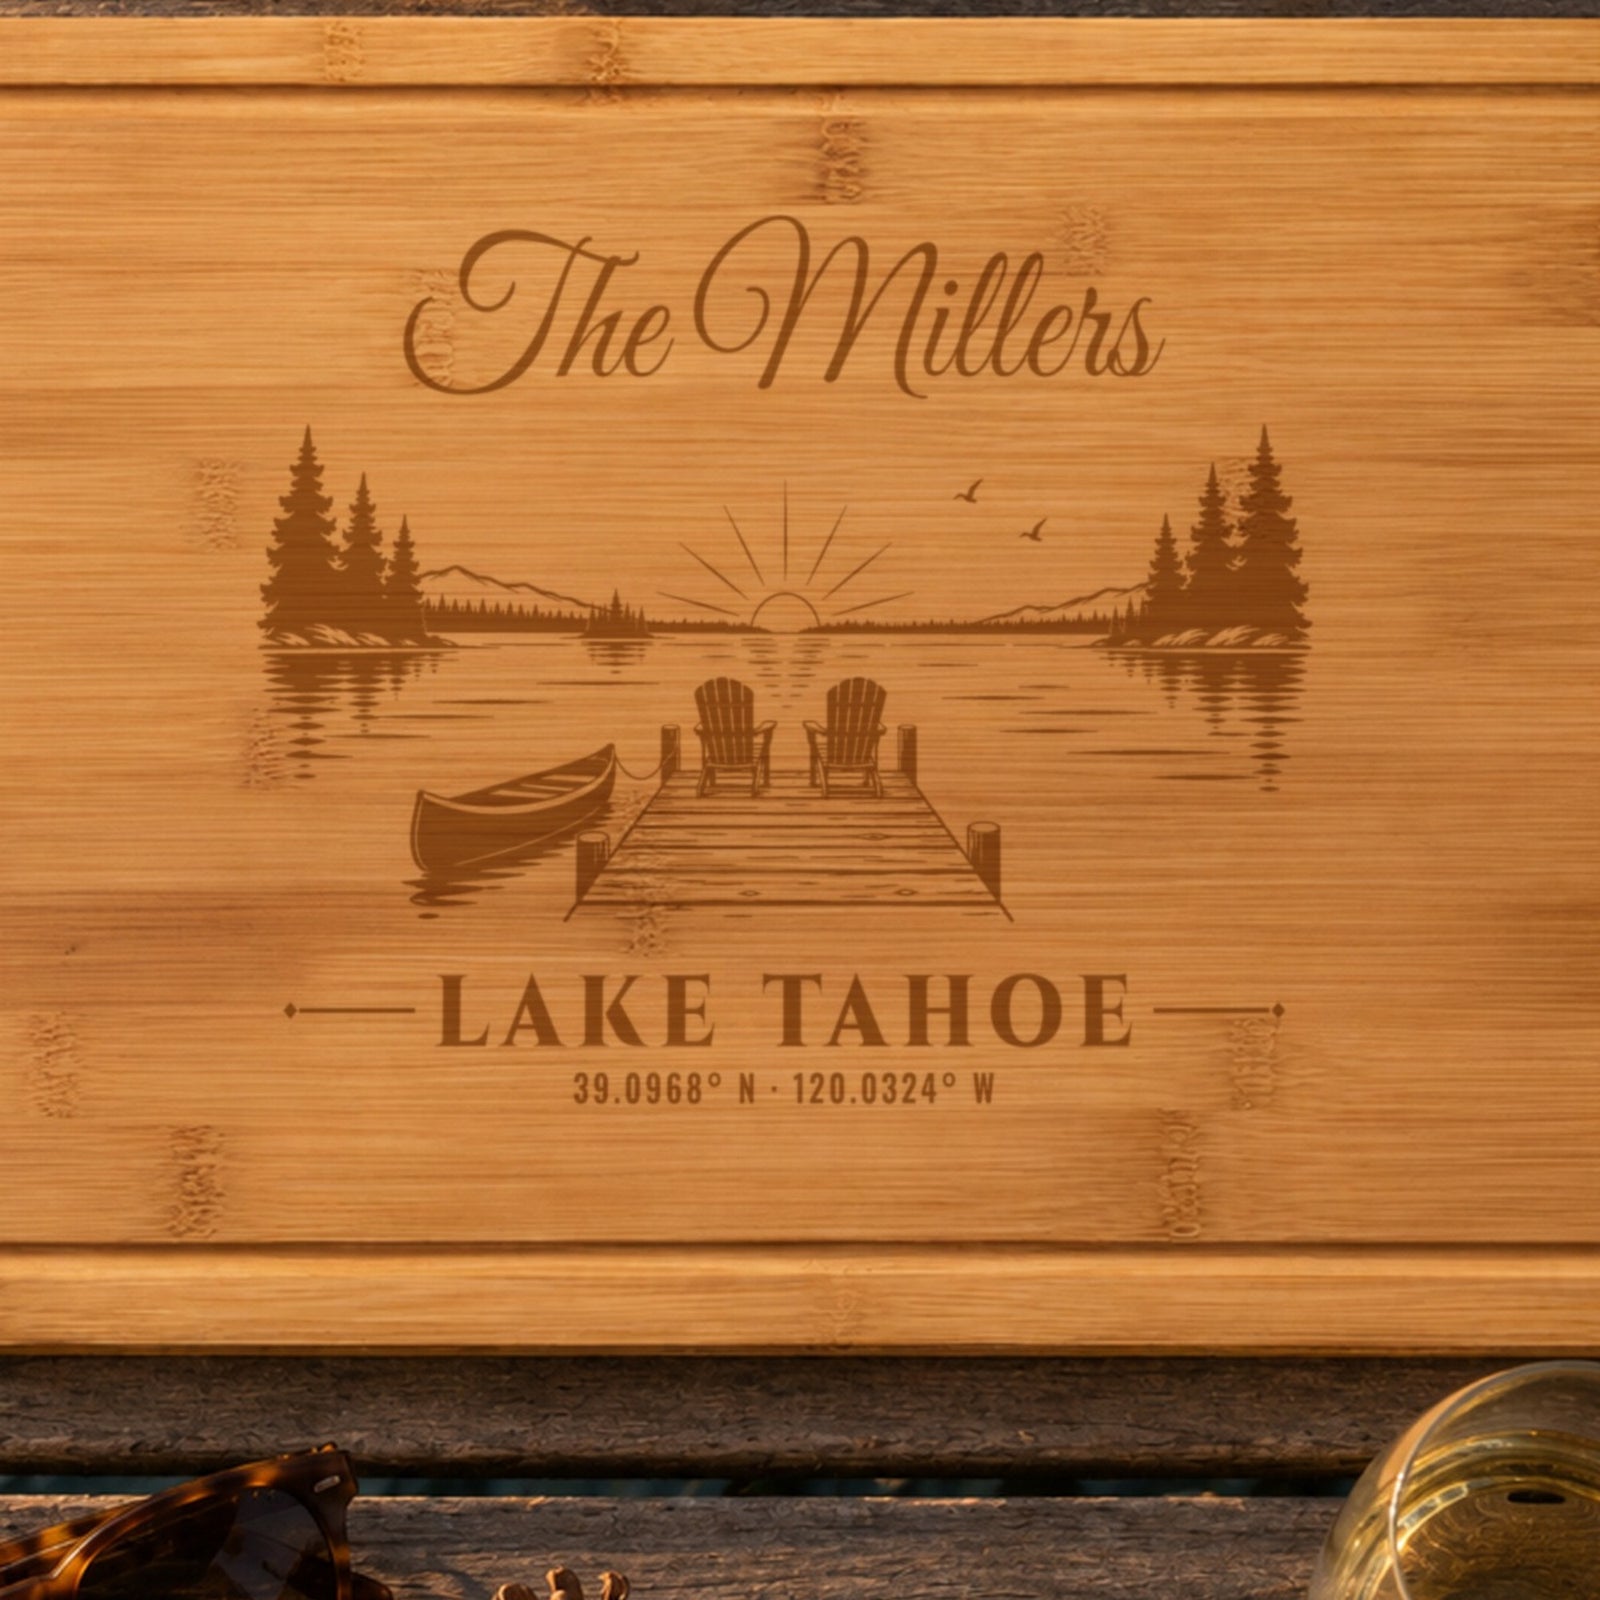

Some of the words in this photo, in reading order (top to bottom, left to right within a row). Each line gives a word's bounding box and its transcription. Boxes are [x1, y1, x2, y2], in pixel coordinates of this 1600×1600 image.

[403, 228, 676, 395] The
[693, 214, 1166, 399] Millers
[435, 972, 716, 1048] LAKE
[762, 972, 1134, 1048] TAHOE
[573, 1072, 722, 1105] 39.0968°
[739, 1072, 756, 1104] N
[794, 1072, 957, 1105] 120.0324°
[973, 1072, 995, 1104] W
